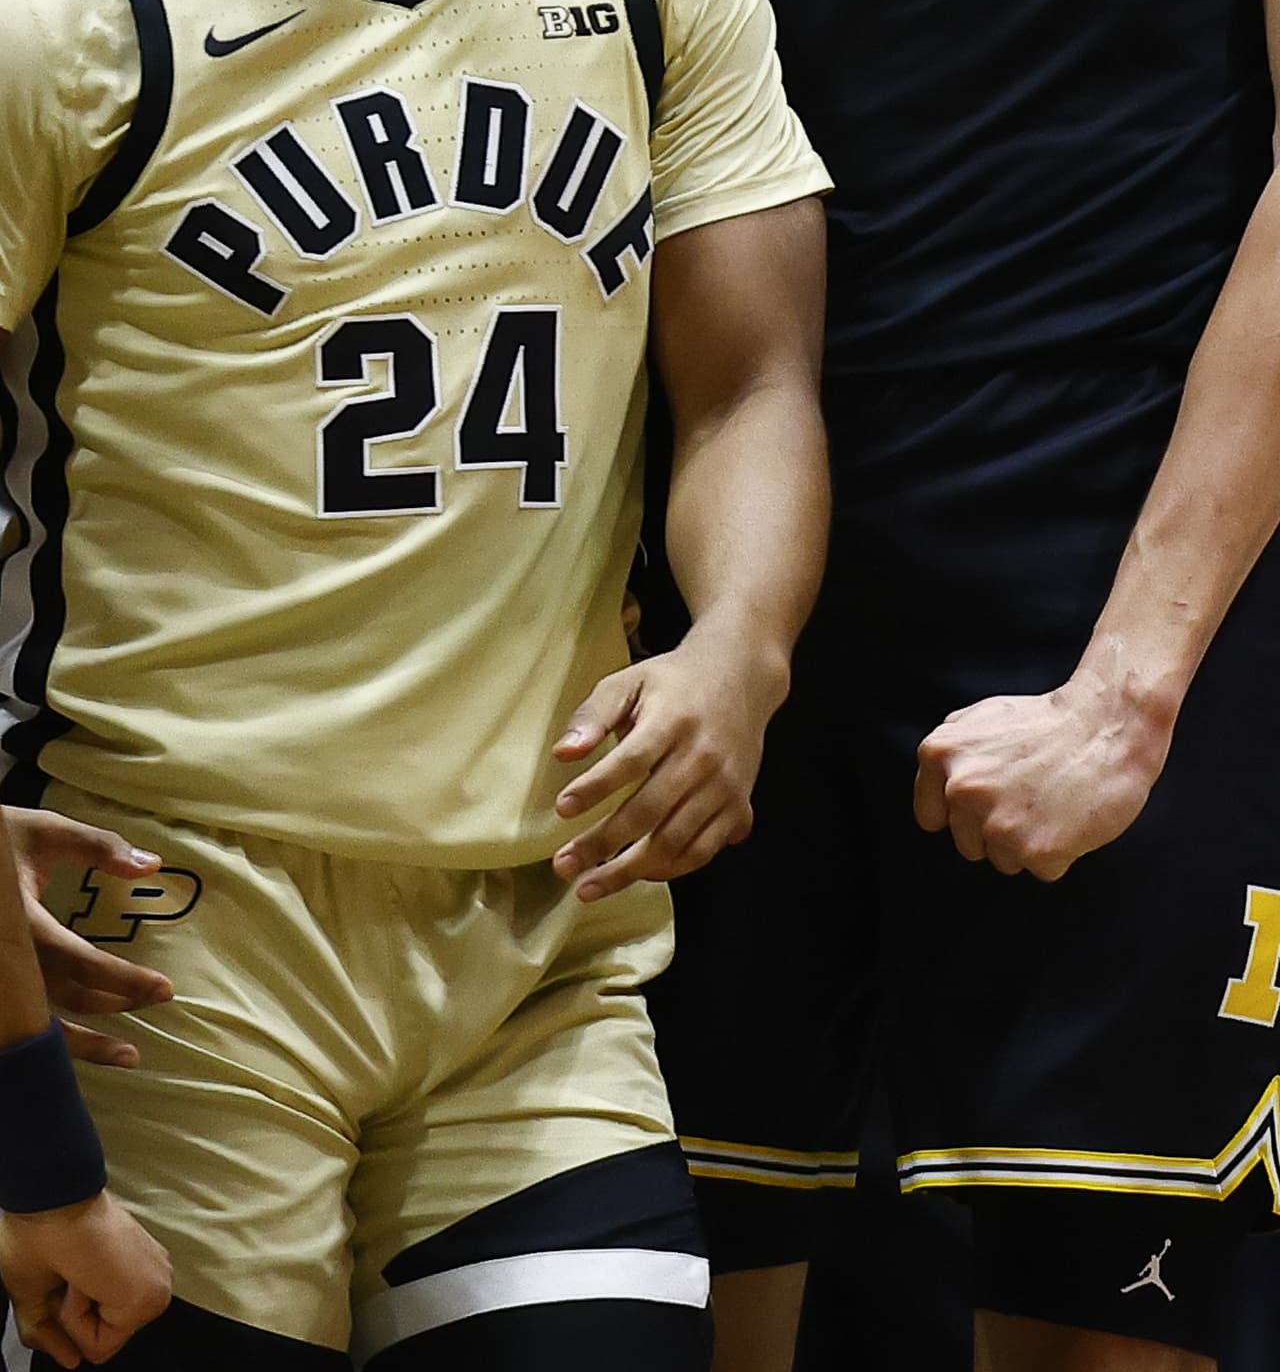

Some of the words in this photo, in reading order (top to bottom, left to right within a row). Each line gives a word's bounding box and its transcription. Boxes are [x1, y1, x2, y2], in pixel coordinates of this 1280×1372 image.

[537, 2, 620, 39] BIG
[159, 74, 655, 319] PURDUE
[315, 303, 570, 520] 24
[69, 866, 203, 943] P
